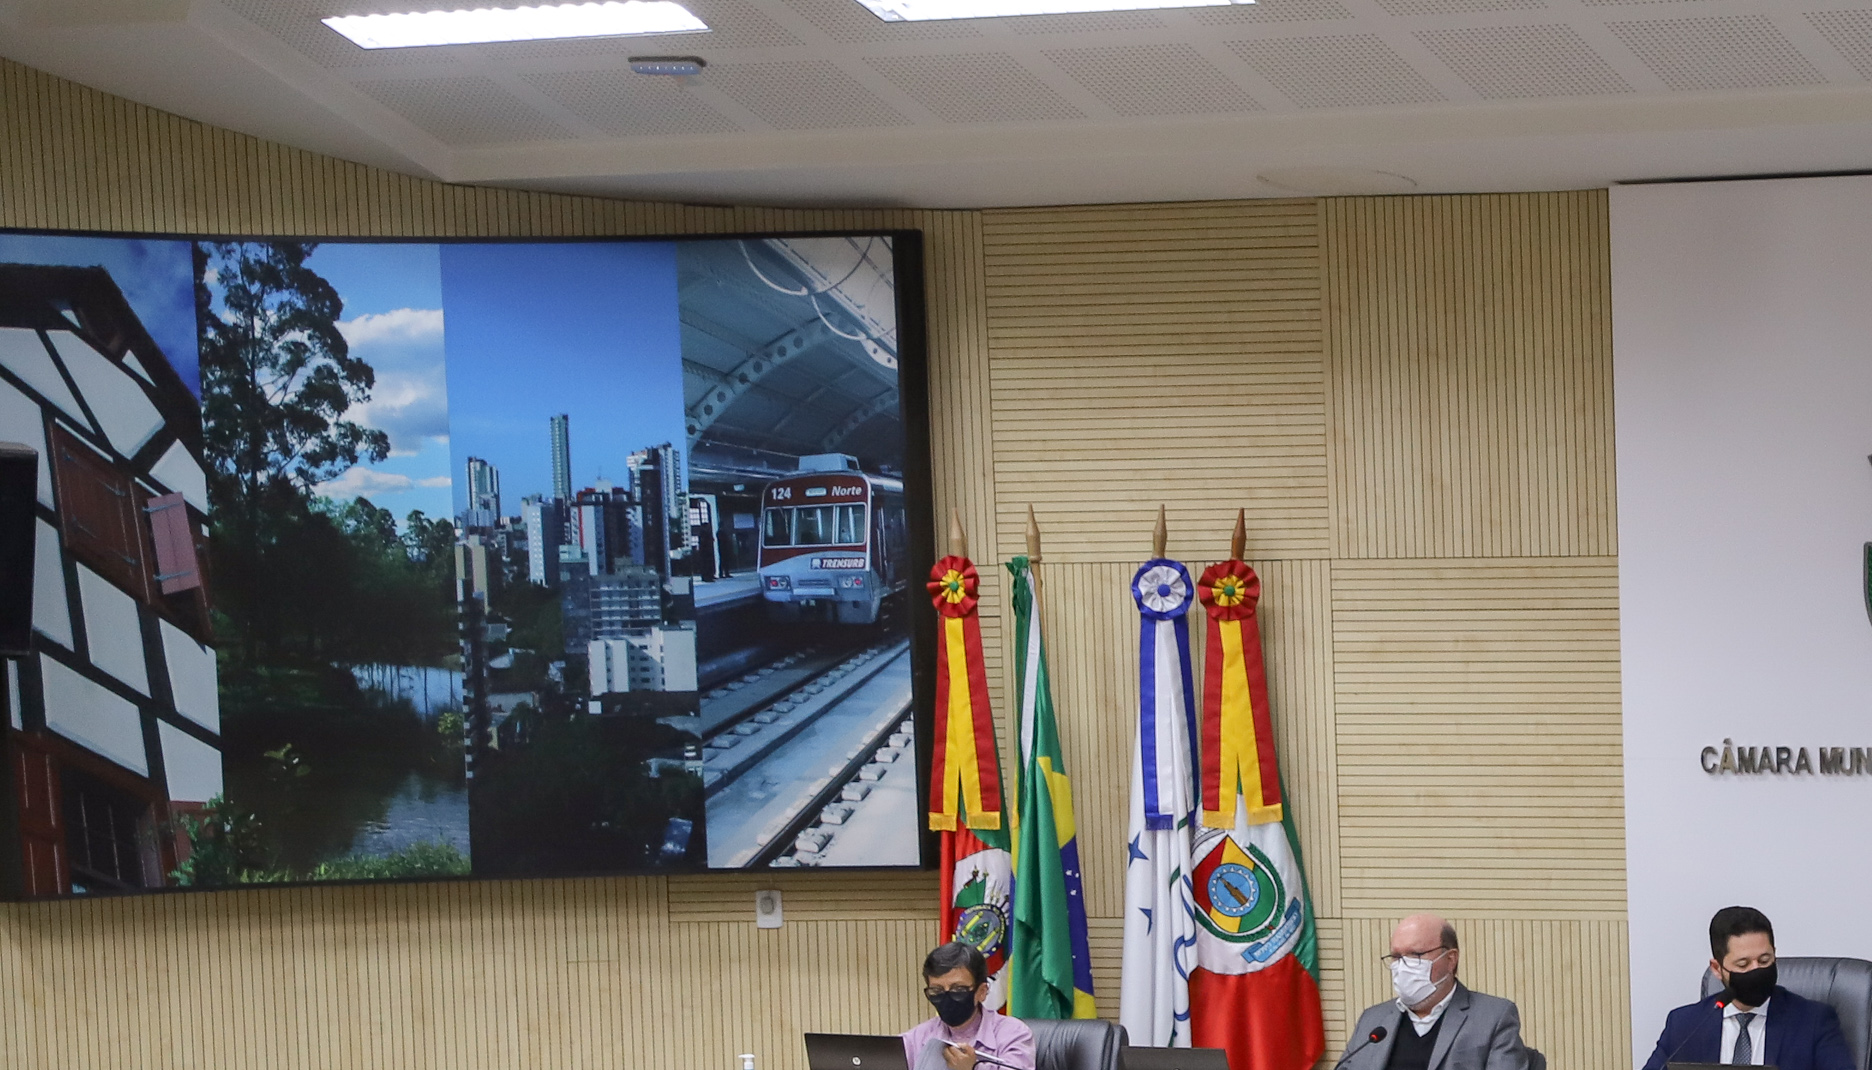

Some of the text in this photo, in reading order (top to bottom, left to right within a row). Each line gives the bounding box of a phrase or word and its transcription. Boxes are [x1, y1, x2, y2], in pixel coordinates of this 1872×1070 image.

[771, 487, 791, 500] 124
[831, 486, 862, 497] Norte
[1700, 738, 1812, 776] CÂMARA
